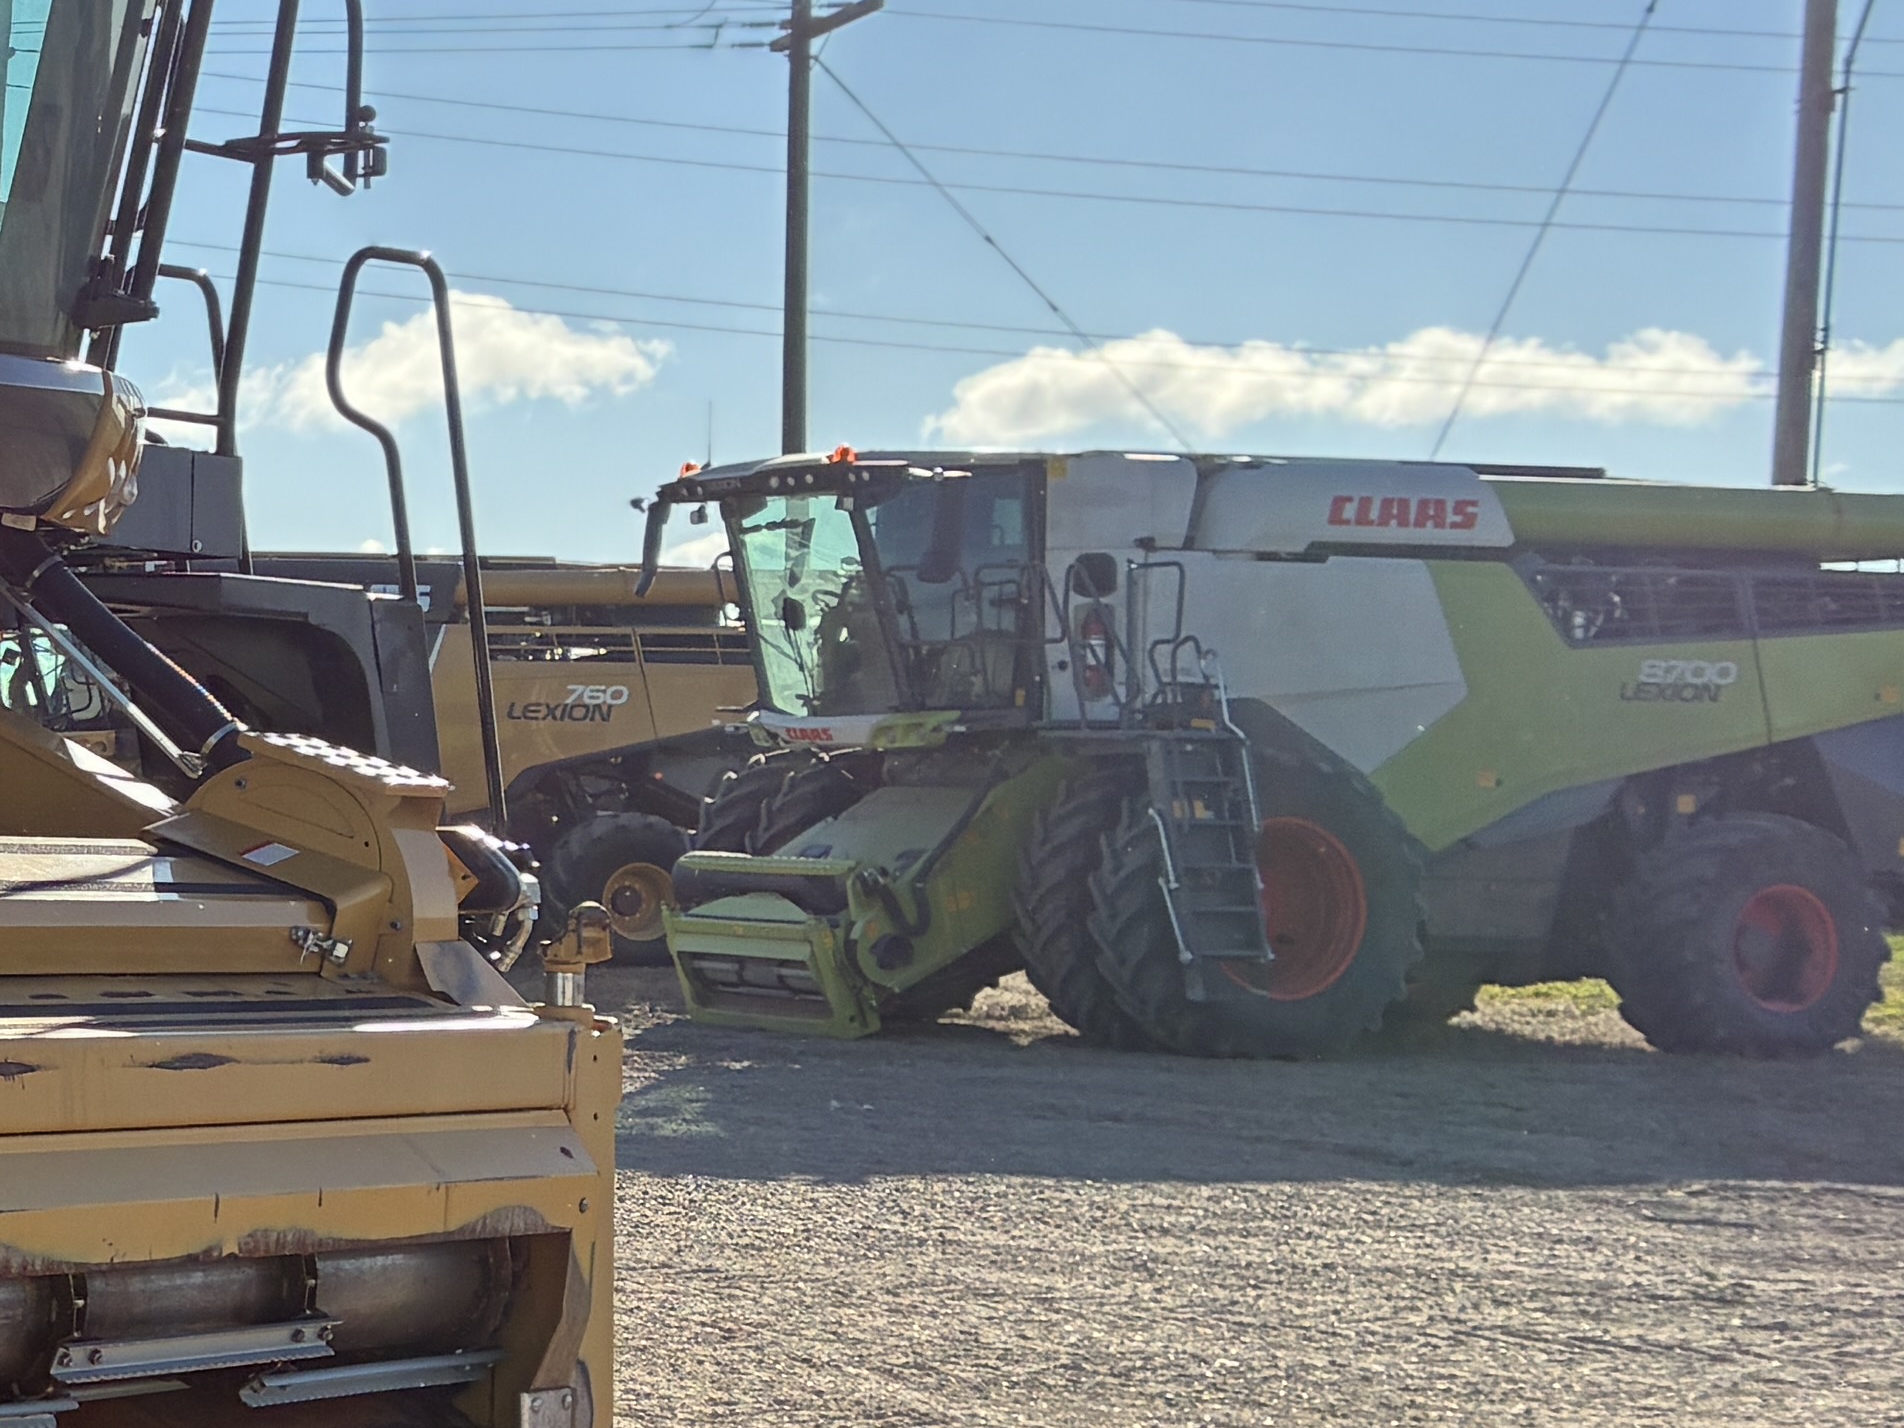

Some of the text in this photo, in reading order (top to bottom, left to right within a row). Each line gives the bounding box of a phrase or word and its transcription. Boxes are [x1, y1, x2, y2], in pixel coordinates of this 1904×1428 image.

[1327, 495, 1480, 530] CLAAS
[563, 684, 630, 705] 760
[506, 702, 613, 723] LEXION
[785, 727, 834, 742] CLAAS
